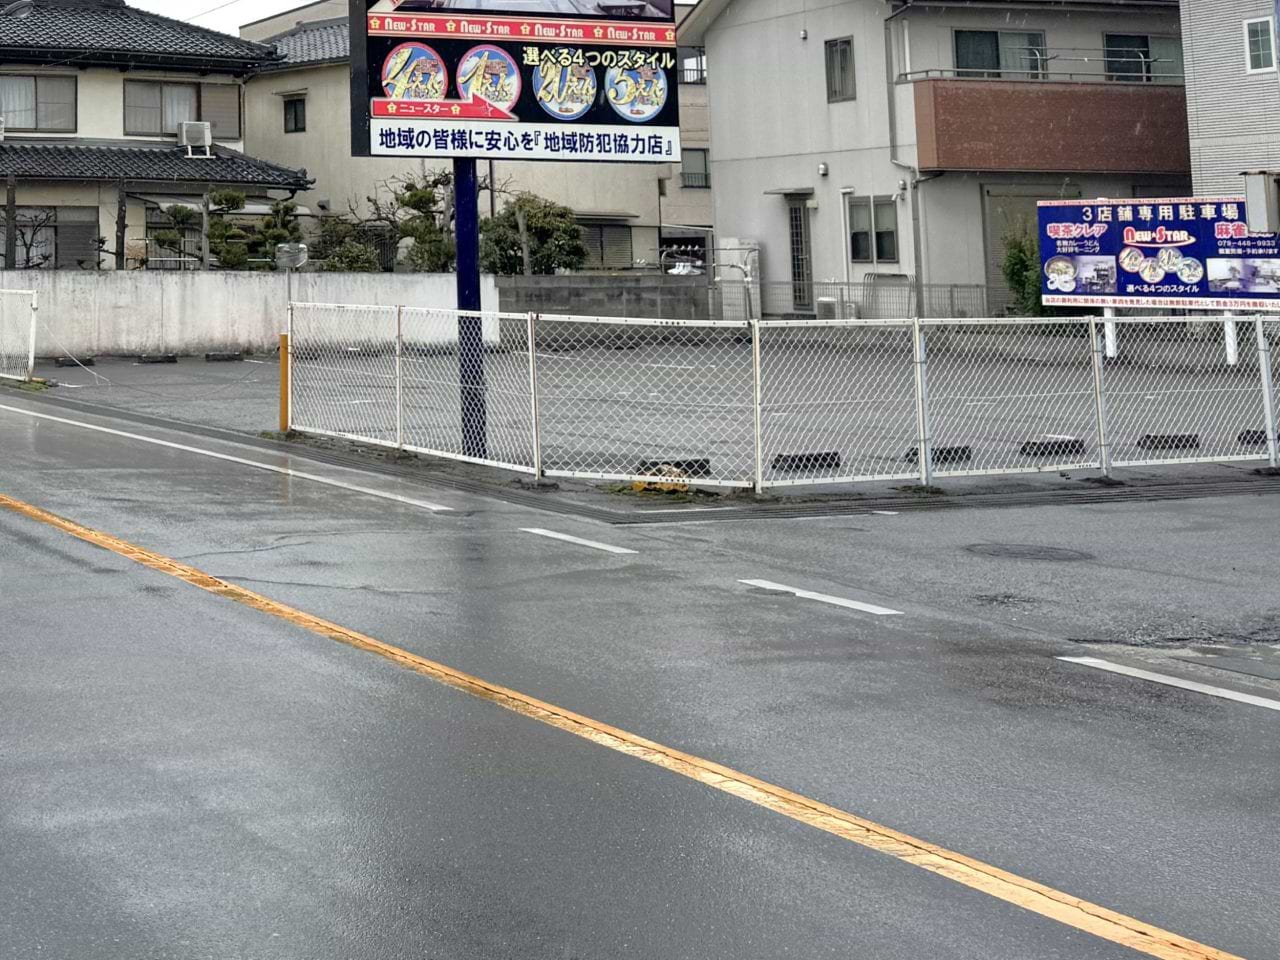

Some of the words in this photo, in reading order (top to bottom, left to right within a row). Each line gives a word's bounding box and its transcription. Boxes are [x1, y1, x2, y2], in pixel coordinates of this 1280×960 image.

[522, 45, 675, 69] 選べる4つのスタイル
[400, 103, 449, 114] ニュースター
[1082, 203, 1239, 222] 3店舗専用駐車場
[1048, 223, 1107, 238] 喫茶クレア
